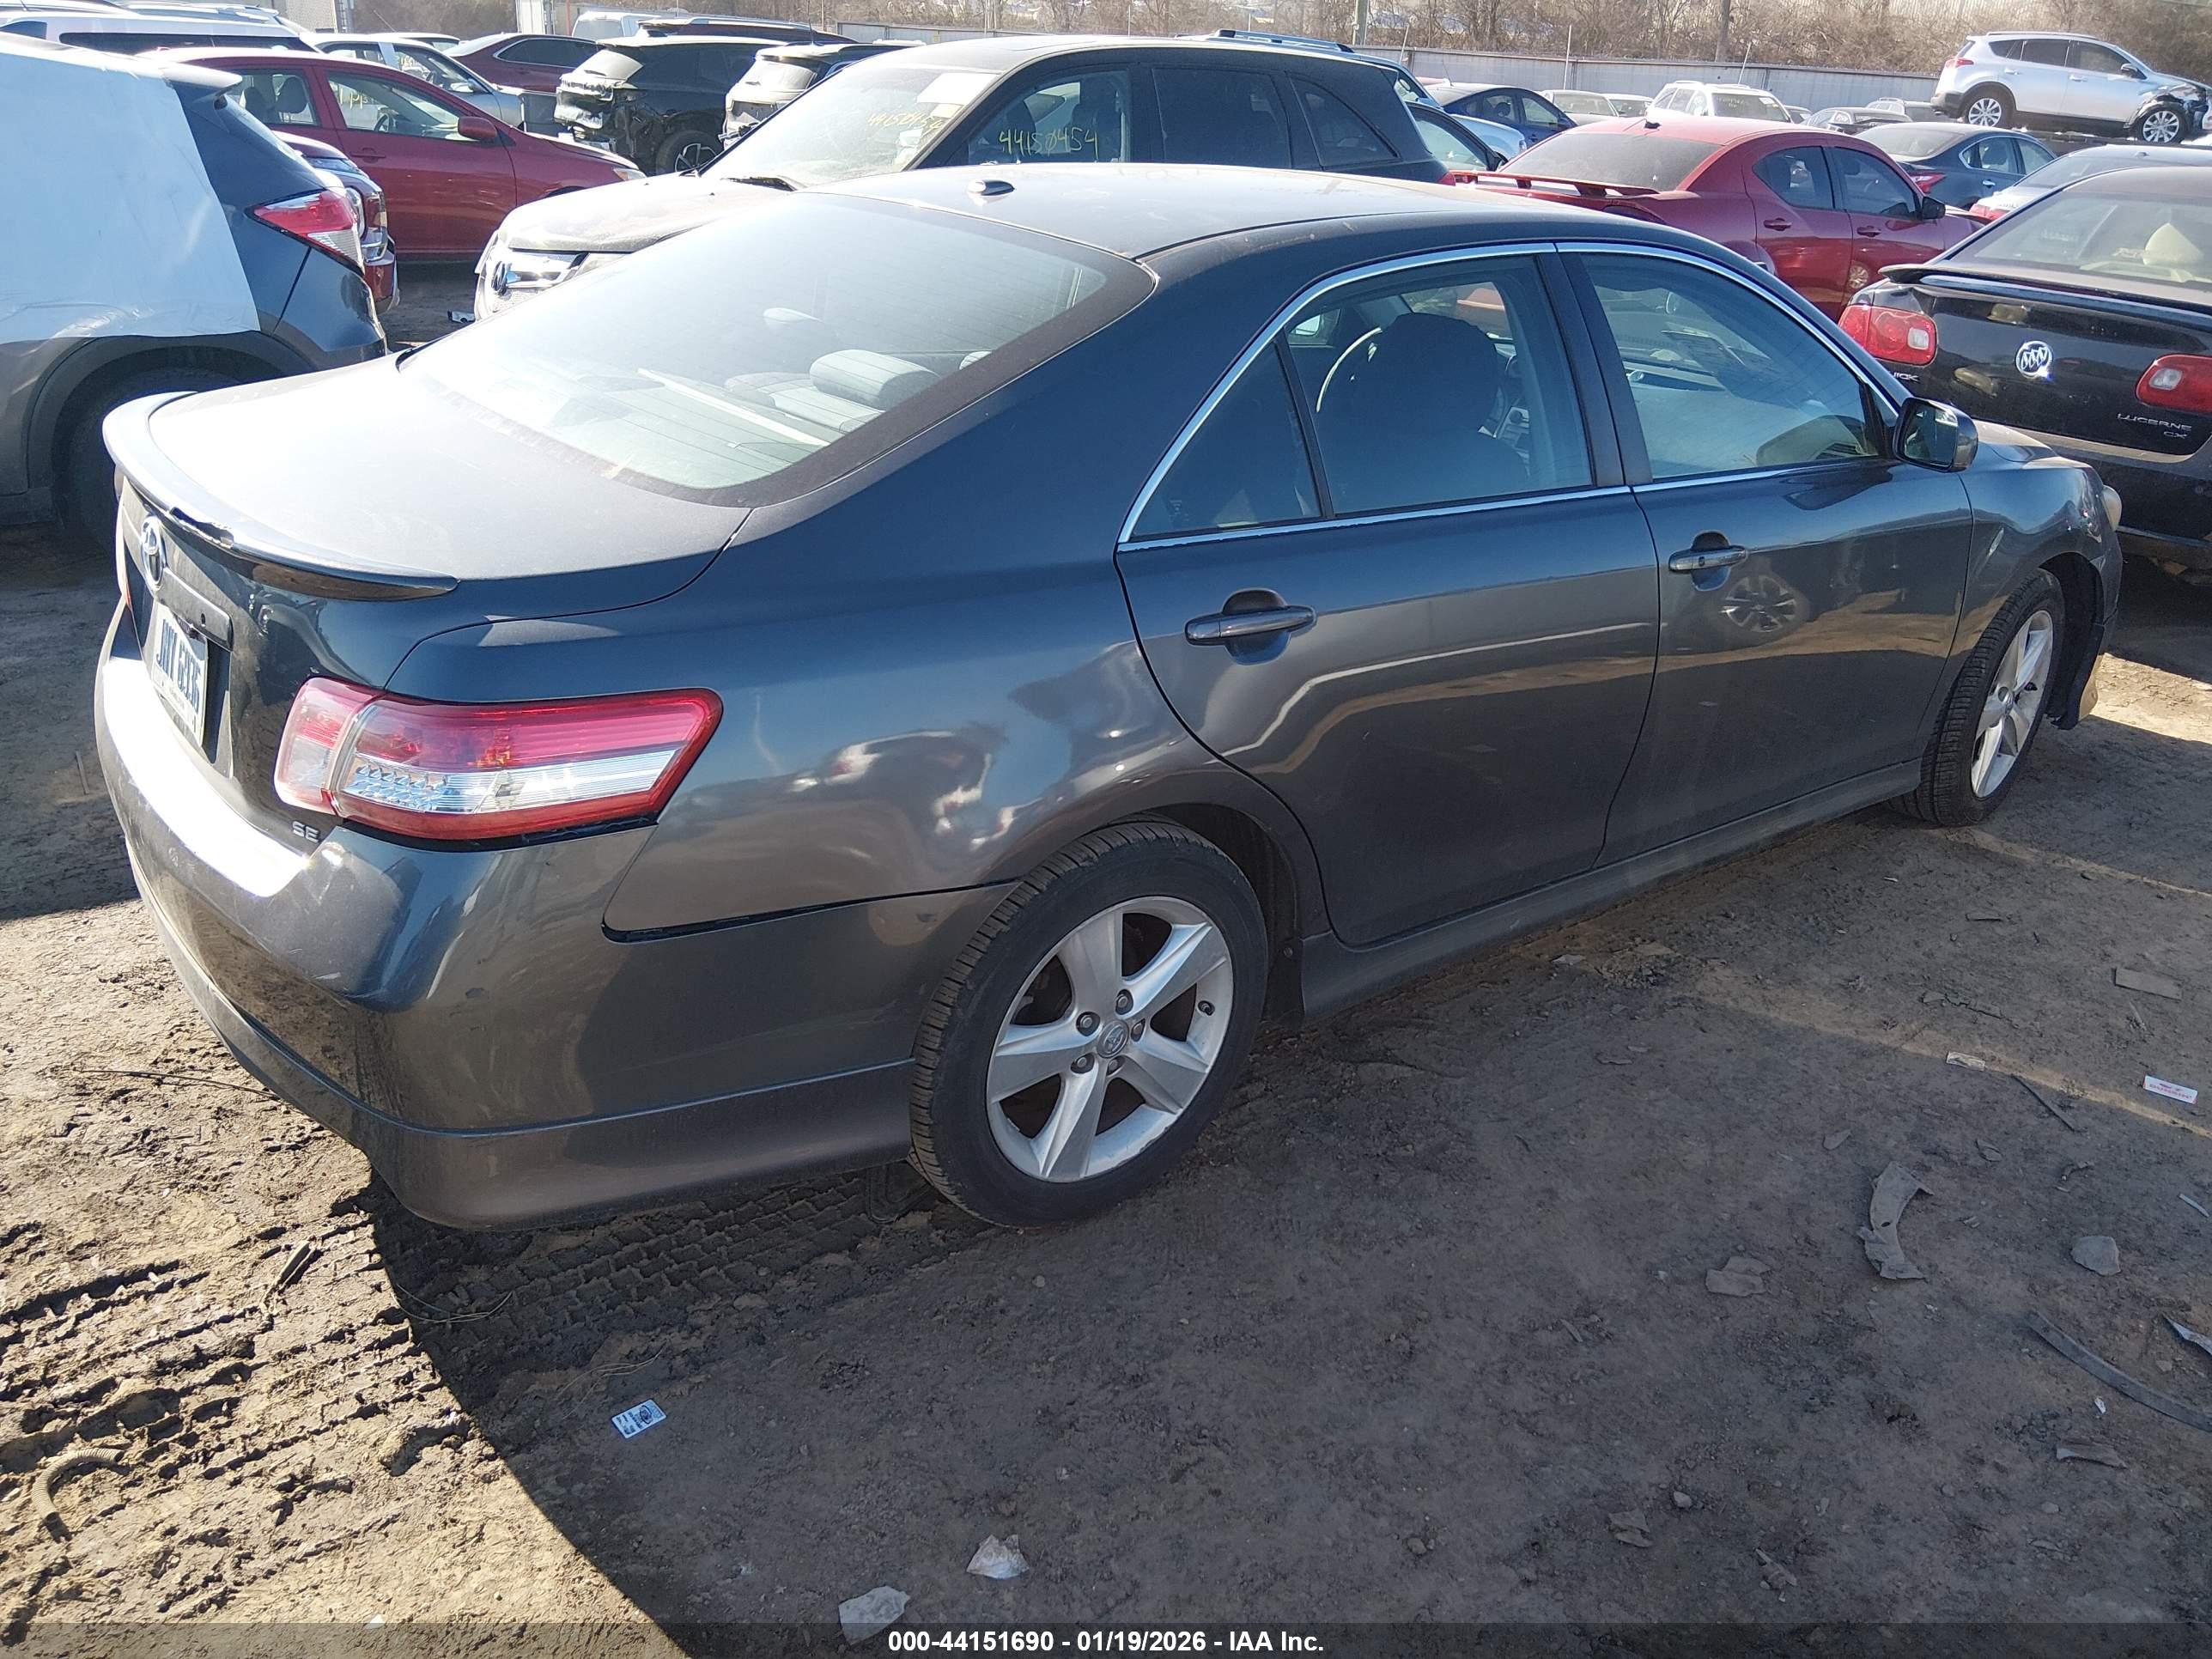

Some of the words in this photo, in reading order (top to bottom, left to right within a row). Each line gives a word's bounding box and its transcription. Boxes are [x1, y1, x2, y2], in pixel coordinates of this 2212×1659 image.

[998, 125, 1099, 161] 44150454
[2117, 413, 2192, 432] LUCERNE
[2163, 431, 2188, 440] CX
[292, 820, 319, 843] SE
